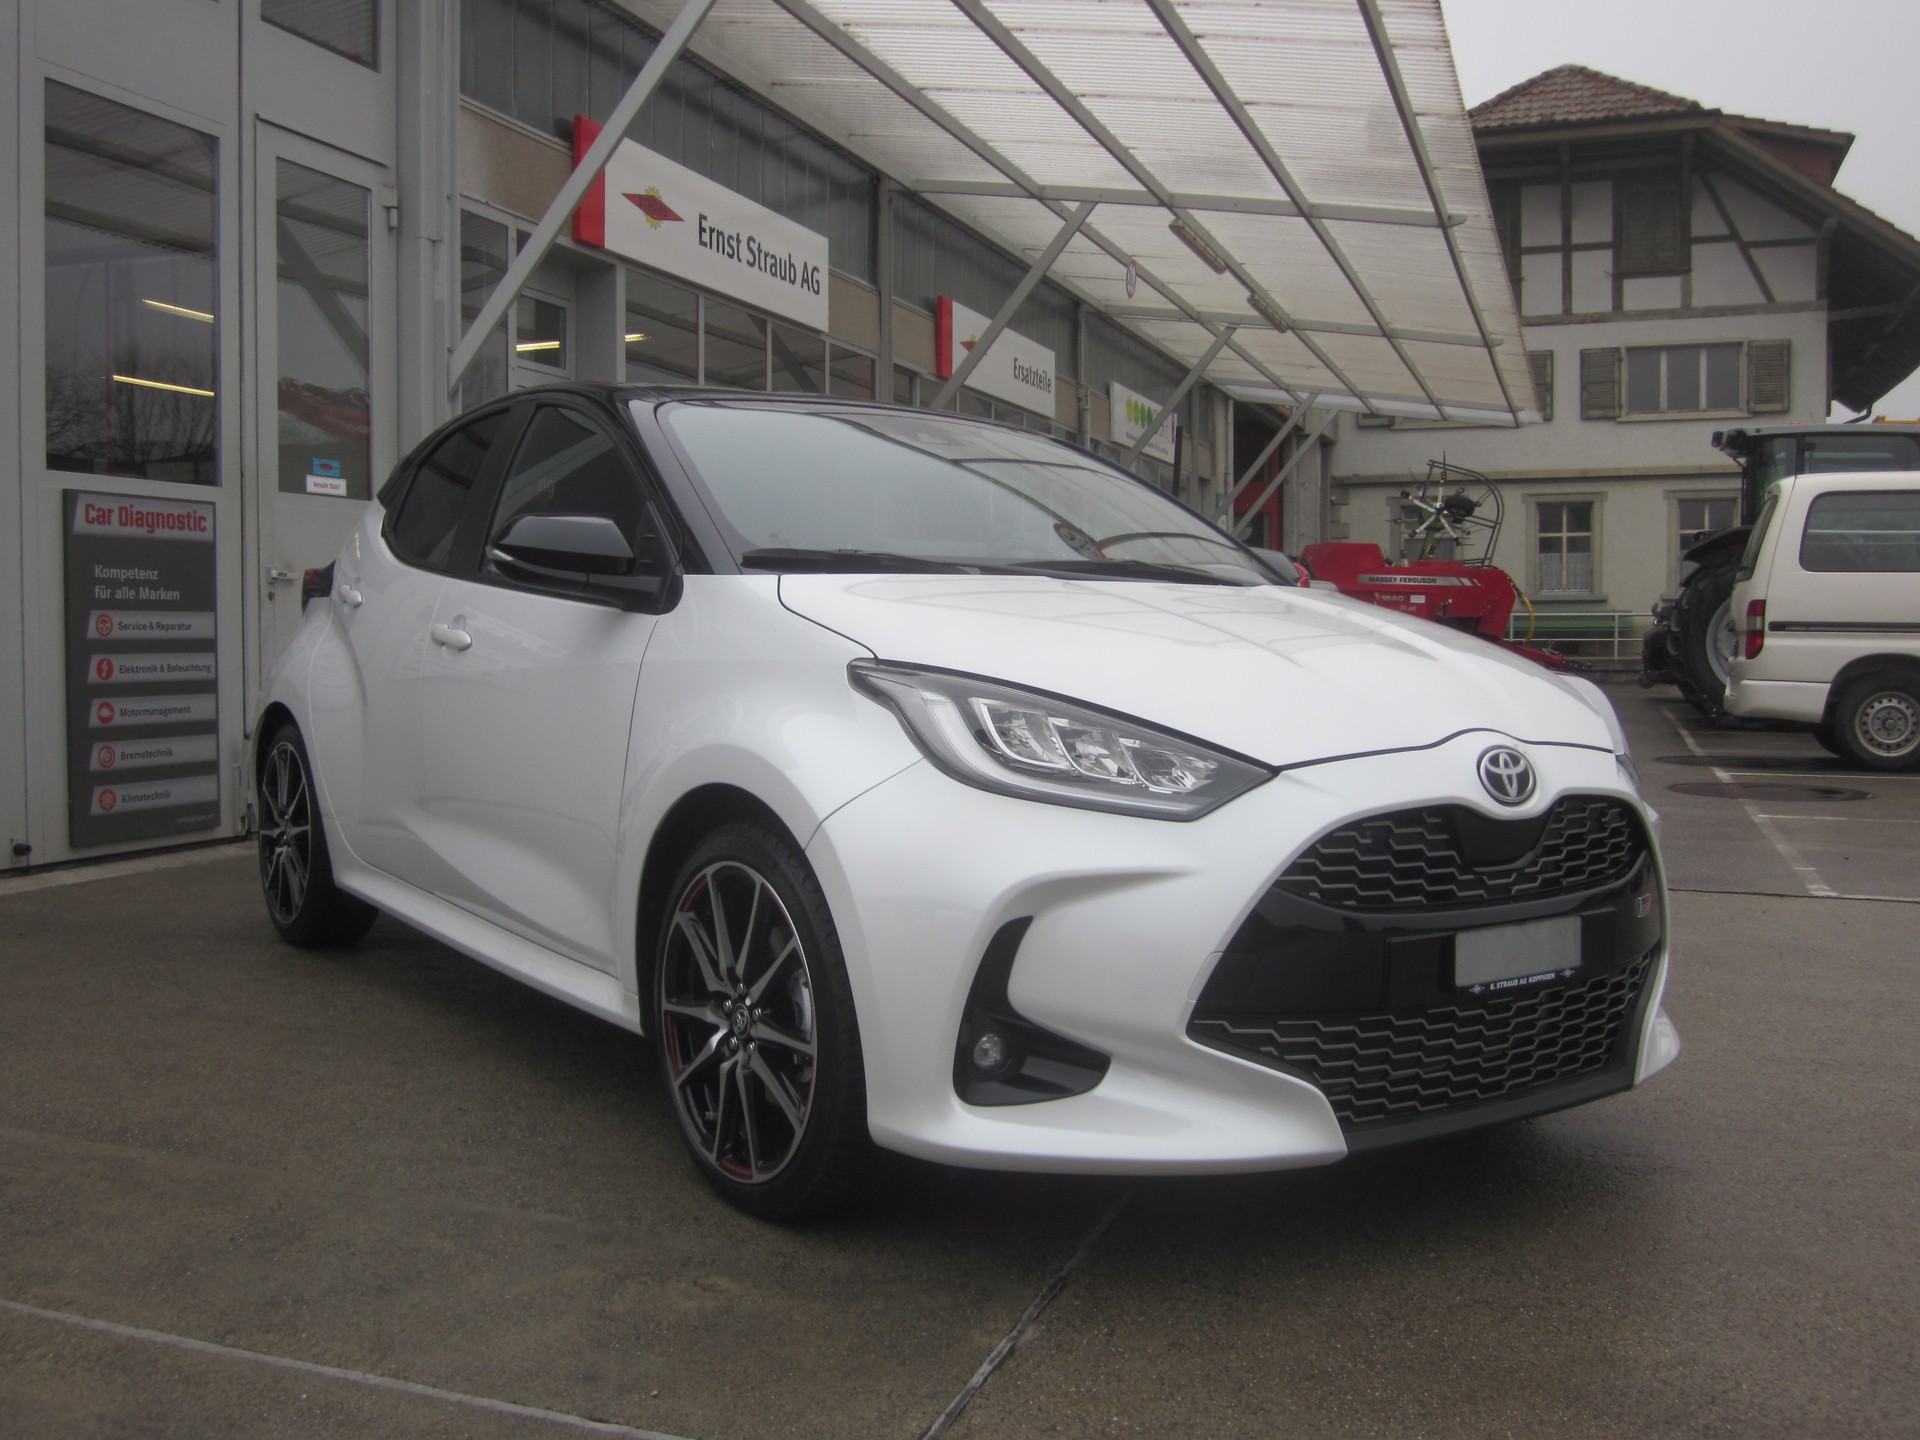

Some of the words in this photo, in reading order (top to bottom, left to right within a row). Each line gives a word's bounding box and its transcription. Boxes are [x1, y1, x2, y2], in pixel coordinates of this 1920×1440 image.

[699, 213, 742, 262] Ernst
[746, 236, 796, 285] Straub
[800, 262, 820, 295] AG
[1014, 357, 1052, 394] Ersatzteile
[84, 503, 114, 526] Car
[118, 504, 207, 534] Diagnostic
[94, 565, 158, 582] Kompetenz
[1368, 576, 1397, 584] MASSEY
[94, 586, 112, 599] für
[115, 586, 135, 600] alle
[140, 587, 180, 600] Marken
[118, 621, 147, 631] Service
[149, 622, 154, 630] &
[156, 622, 192, 632] Reparatur
[119, 664, 158, 674] Elektronik
[160, 664, 165, 673] &
[167, 663, 212, 673] Beleuchtung
[120, 706, 191, 717] Motormanagement
[120, 748, 173, 760] Bremstechnik
[122, 790, 171, 803] Klimatechnik
[1496, 979, 1518, 989] STRAUB
